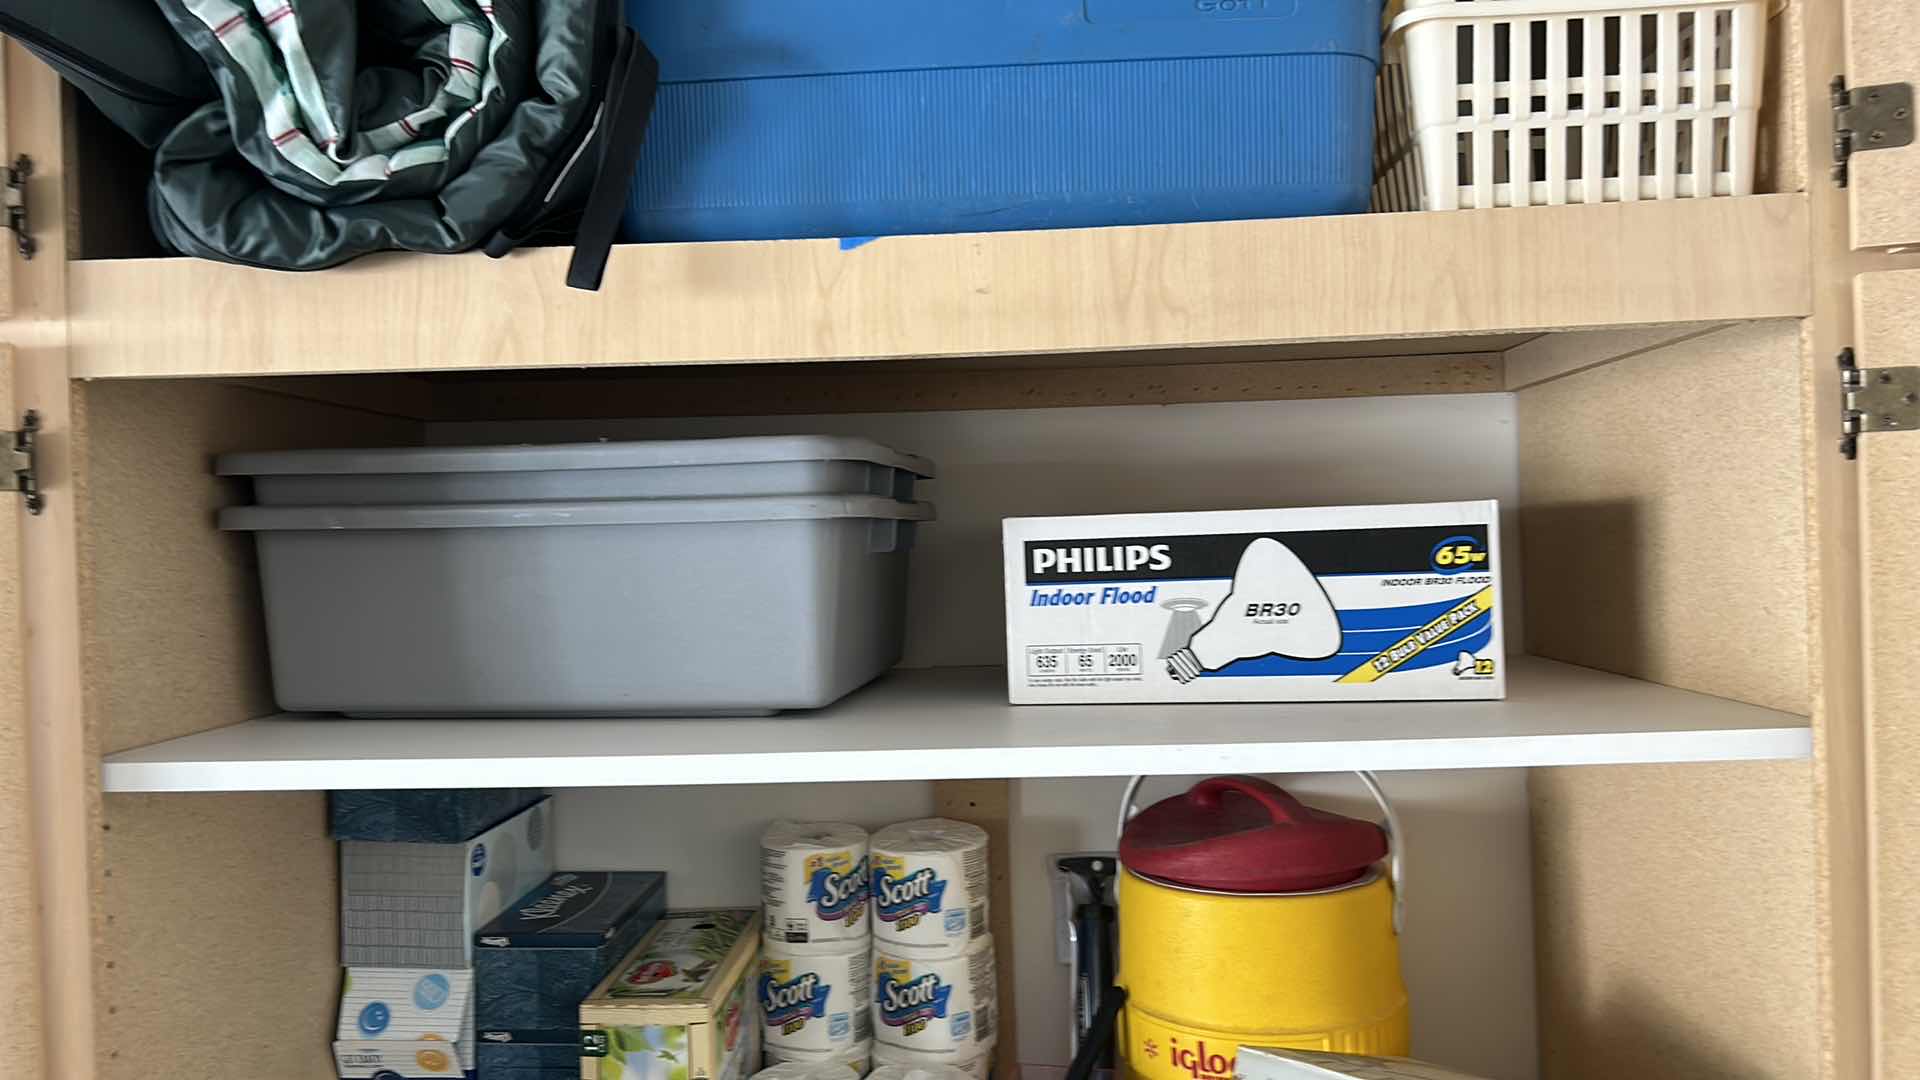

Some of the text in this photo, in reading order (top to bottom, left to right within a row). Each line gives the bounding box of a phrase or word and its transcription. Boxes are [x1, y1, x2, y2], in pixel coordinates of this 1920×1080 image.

[1032, 544, 1173, 574] PHILIPS
[1030, 586, 1158, 607] Indoor Flood
[1245, 602, 1301, 617] BR30
[1448, 599, 1479, 625] PACK
[1036, 655, 1058, 668] 635
[1079, 654, 1094, 667] 65
[1109, 653, 1138, 667] 2000
[1475, 659, 1494, 675] 12
[879, 868, 934, 907] Scott
[767, 974, 817, 1012] Scott
[883, 975, 938, 1012] Scott
